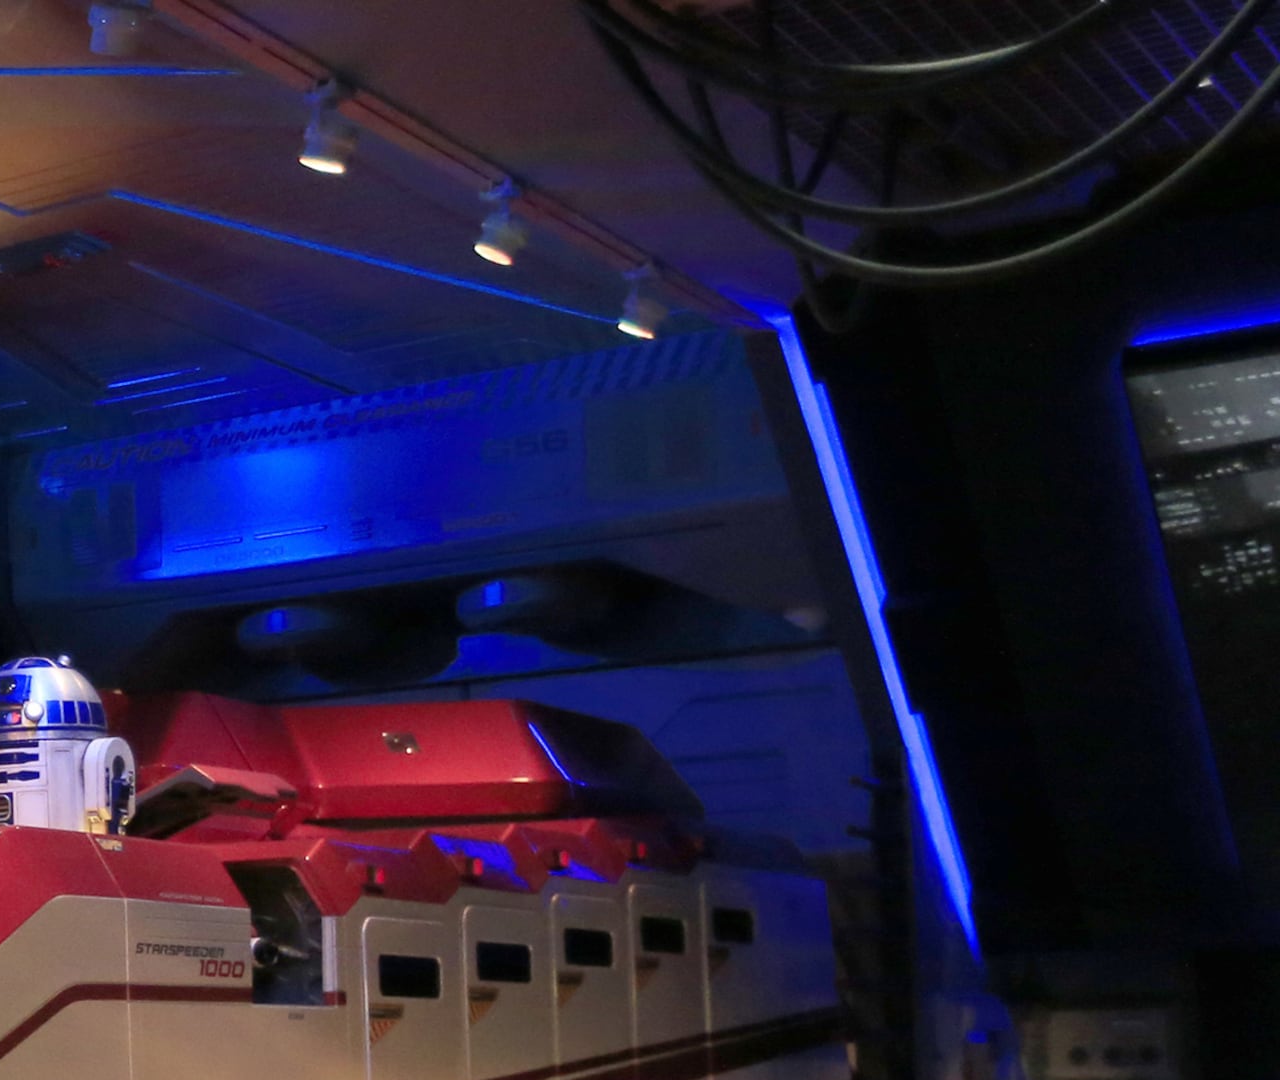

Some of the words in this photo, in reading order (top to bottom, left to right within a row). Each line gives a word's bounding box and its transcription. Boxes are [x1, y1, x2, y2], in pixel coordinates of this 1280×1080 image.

[207, 420, 317, 448] MINIMUM
[135, 942, 225, 958] STARSPEEDER
[199, 959, 245, 978] 1000
